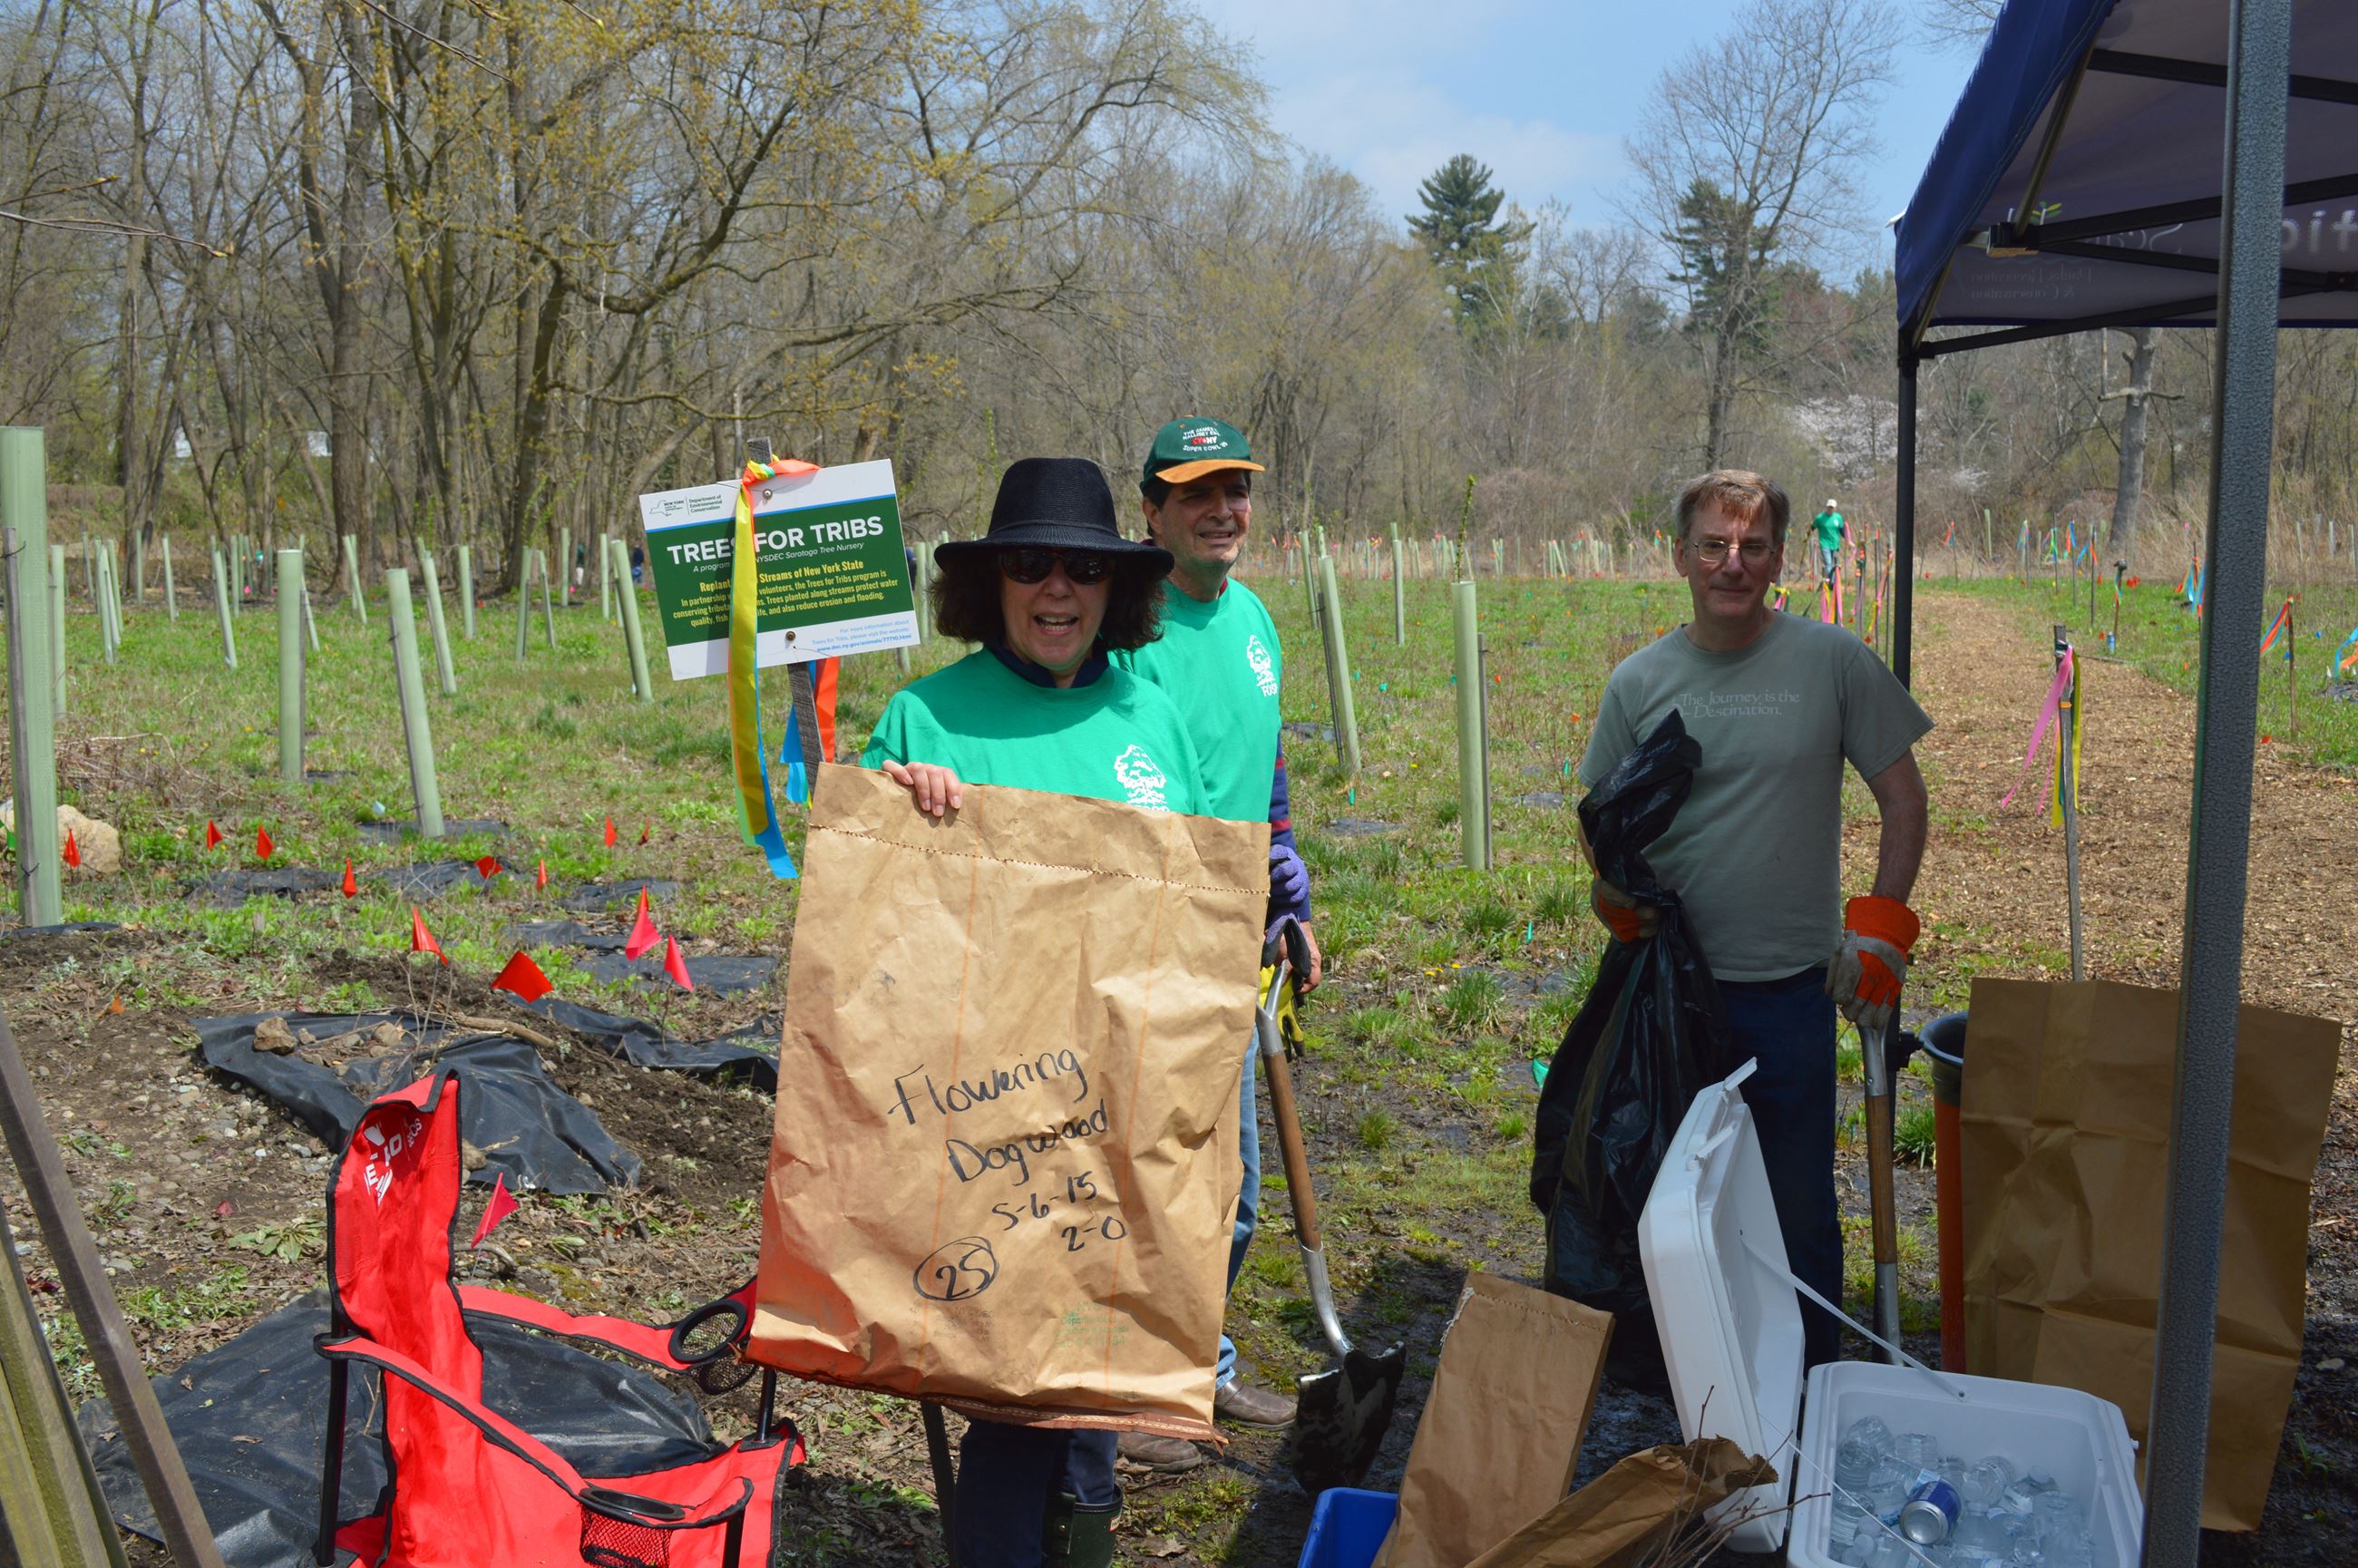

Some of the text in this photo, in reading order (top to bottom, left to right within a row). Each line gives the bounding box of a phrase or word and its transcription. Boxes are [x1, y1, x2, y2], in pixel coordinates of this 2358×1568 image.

[754, 527, 805, 553] FOR
[809, 516, 884, 544] TRIBS
[700, 562, 730, 573] program
[755, 552, 785, 564] NYSDEC
[785, 549, 818, 560] Saratoga
[819, 546, 835, 554] Tree
[836, 542, 864, 552] Nursery
[759, 569, 794, 583] Streams
[794, 568, 803, 579] of
[804, 565, 822, 578] New
[822, 562, 841, 574] York
[842, 560, 864, 571] State
[673, 607, 708, 618] conserving
[766, 595, 784, 604] Trees
[784, 590, 810, 602] planted
[810, 589, 828, 599] along
[828, 586, 854, 596] streams
[855, 582, 879, 594] protect
[880, 579, 899, 589] water
[681, 598, 688, 607] In
[689, 594, 726, 607] partnership
[794, 580, 805, 590] the
[807, 579, 824, 589] Trees
[824, 577, 834, 586] for
[834, 574, 852, 584] Tribs
[853, 572, 880, 583] program
[880, 570, 887, 578] is
[691, 617, 716, 628] quality,
[716, 614, 729, 624] fish
[769, 604, 781, 615] and
[782, 603, 795, 612] also
[796, 600, 819, 610] reduce
[819, 598, 843, 608] erosion
[843, 594, 856, 604] and
[1680, 689, 1801, 706] The Journey is the
[1693, 702, 1783, 718] Destination.
[887, 1049, 1088, 1125] Flowering
[946, 1098, 1108, 1186] Dogwood
[935, 1247, 991, 1300] 25
